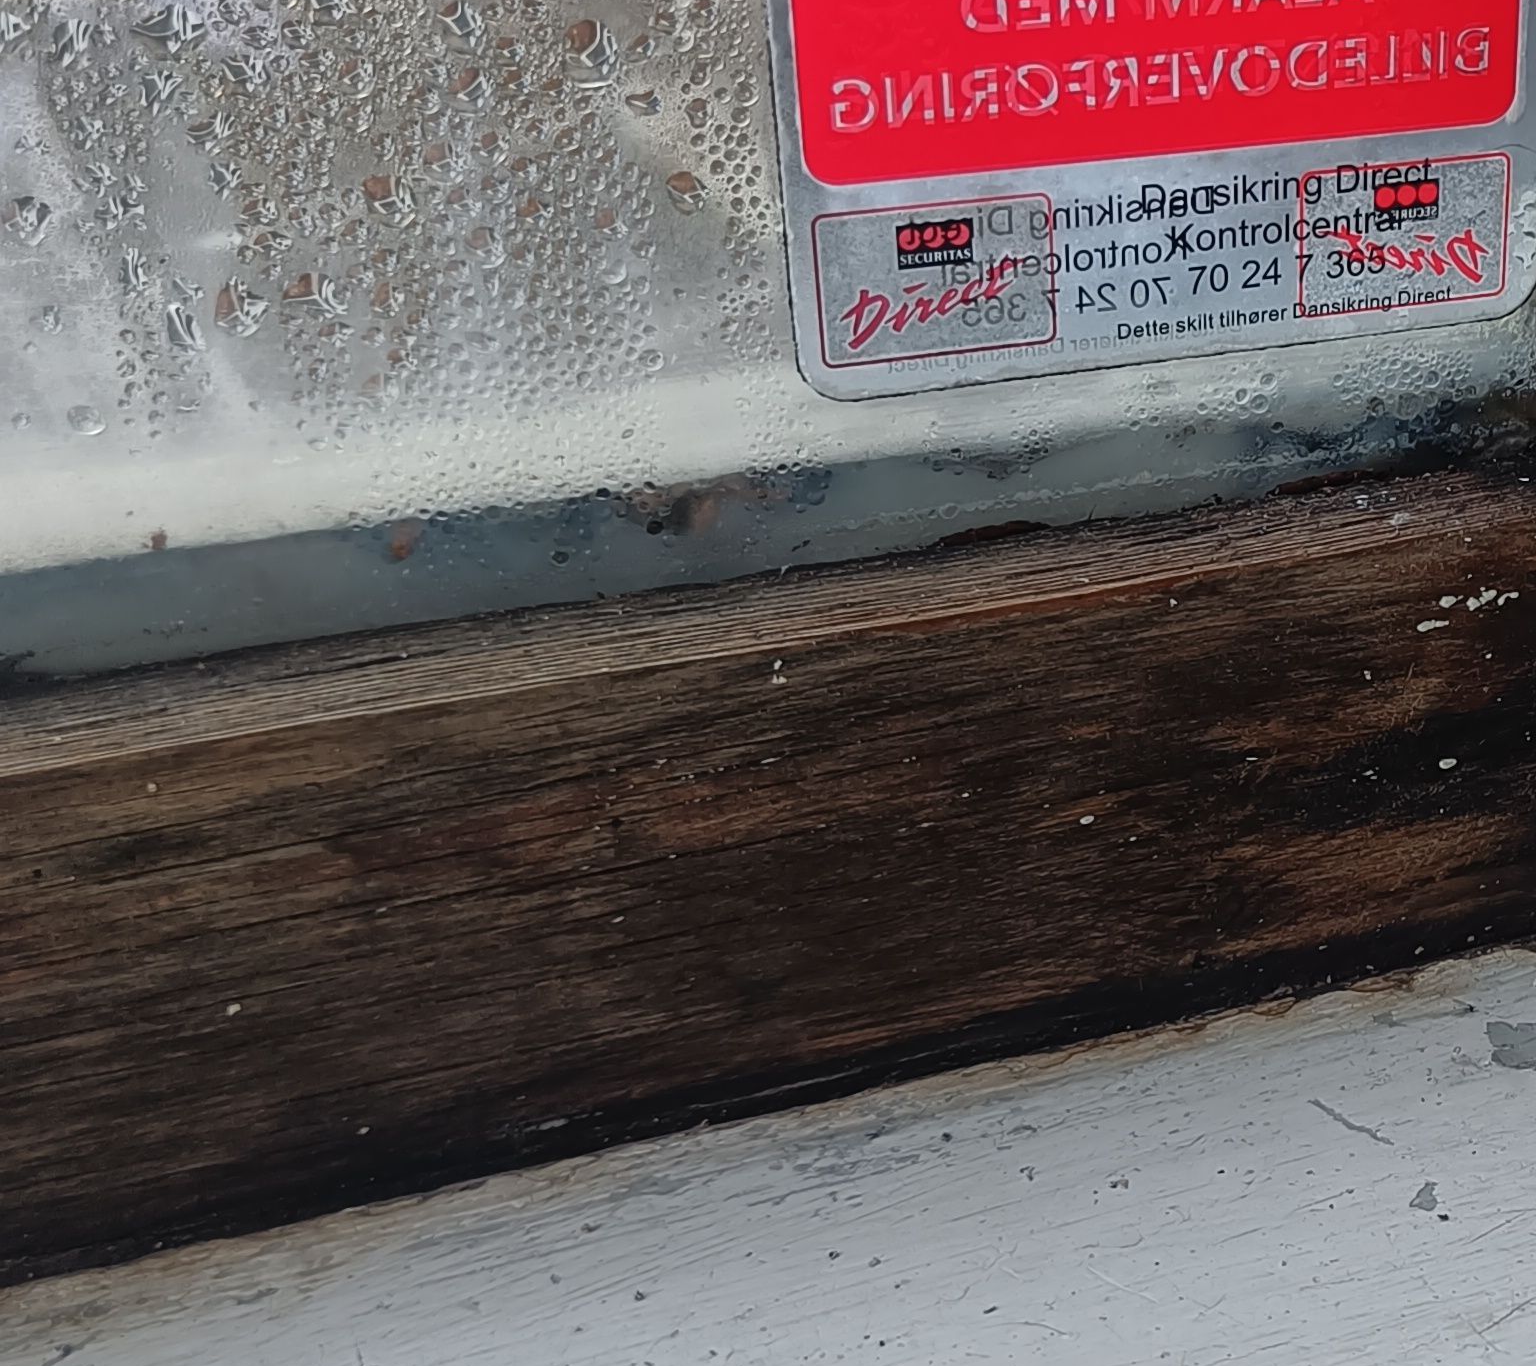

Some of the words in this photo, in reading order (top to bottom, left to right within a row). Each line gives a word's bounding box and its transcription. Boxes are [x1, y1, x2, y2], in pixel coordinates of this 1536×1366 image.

[1142, 172, 1322, 216] Dansikring
[1336, 158, 1432, 194] Direct
[900, 247, 972, 266] SECURITAS
[1188, 263, 1230, 295] 70
[1242, 257, 1283, 290] 24
[1117, 320, 1171, 340] Dette
[1175, 312, 1215, 334] skilt
[1219, 308, 1287, 330] tilhører
[1293, 294, 1392, 319] Dansikring
[1398, 287, 1452, 305] Direct
